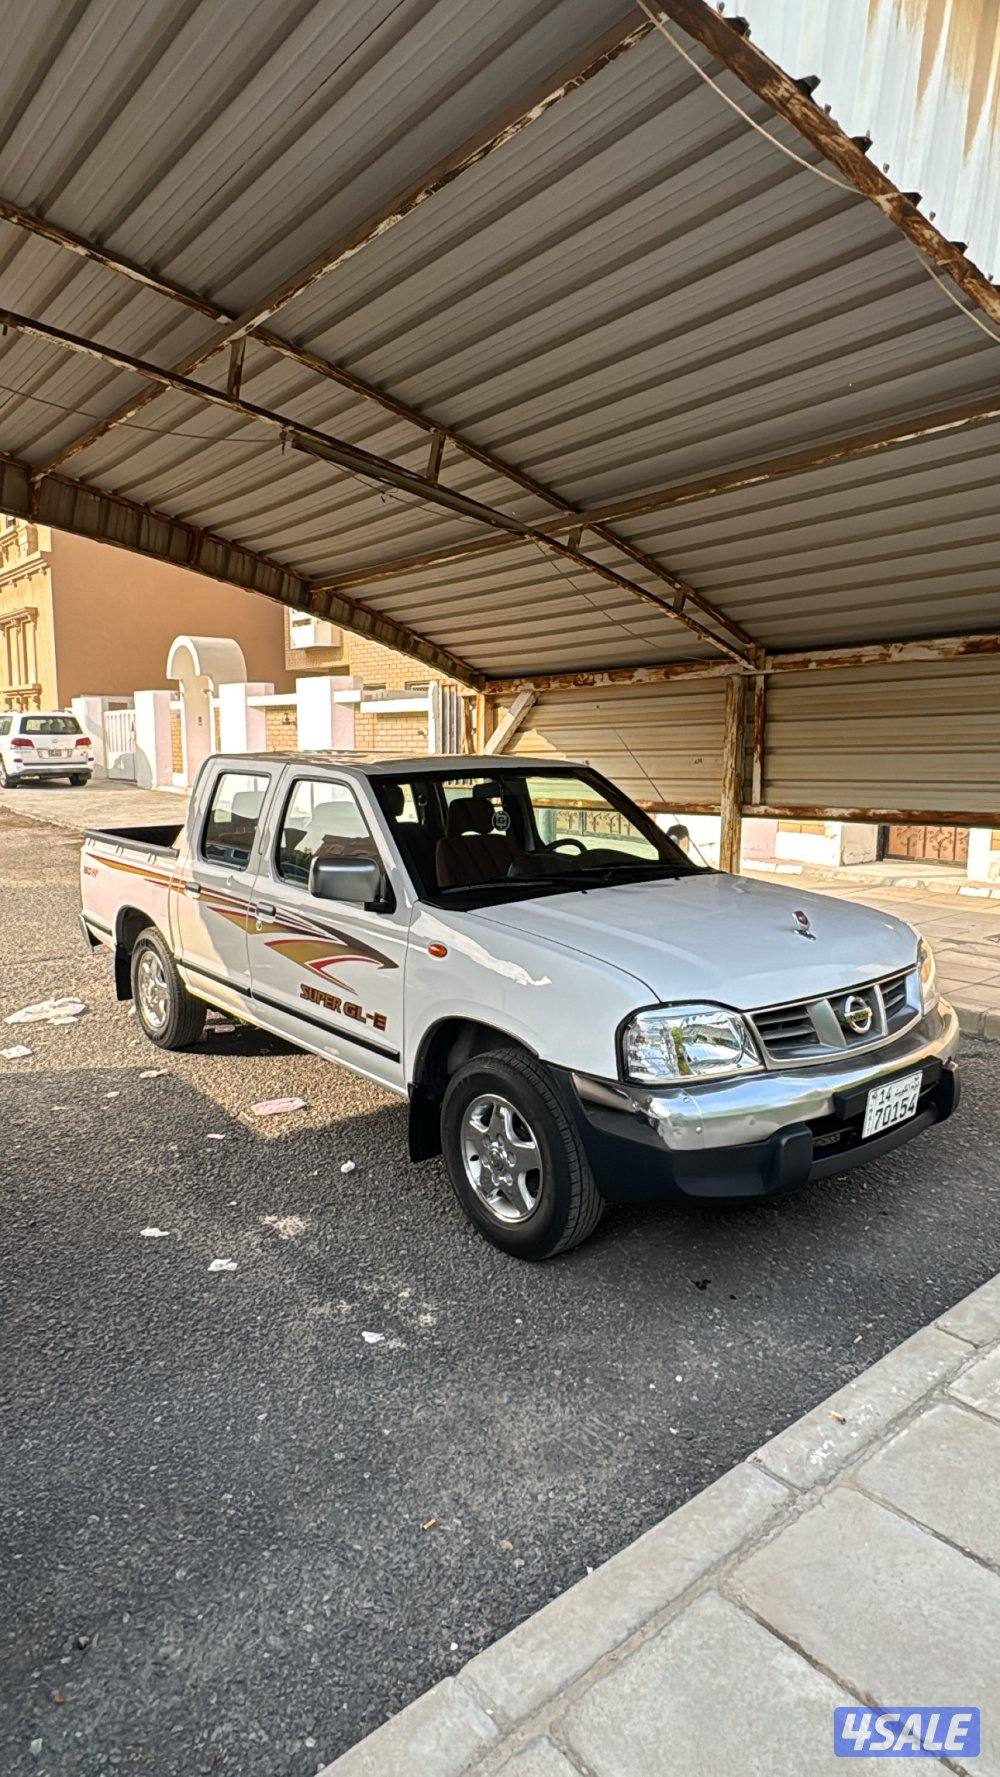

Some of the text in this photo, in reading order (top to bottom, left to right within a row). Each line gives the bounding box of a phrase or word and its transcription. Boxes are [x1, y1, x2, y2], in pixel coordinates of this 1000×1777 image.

[300, 984, 342, 1013] SUPER
[879, 1086, 891, 1105] 14
[875, 1093, 917, 1131] 70154
